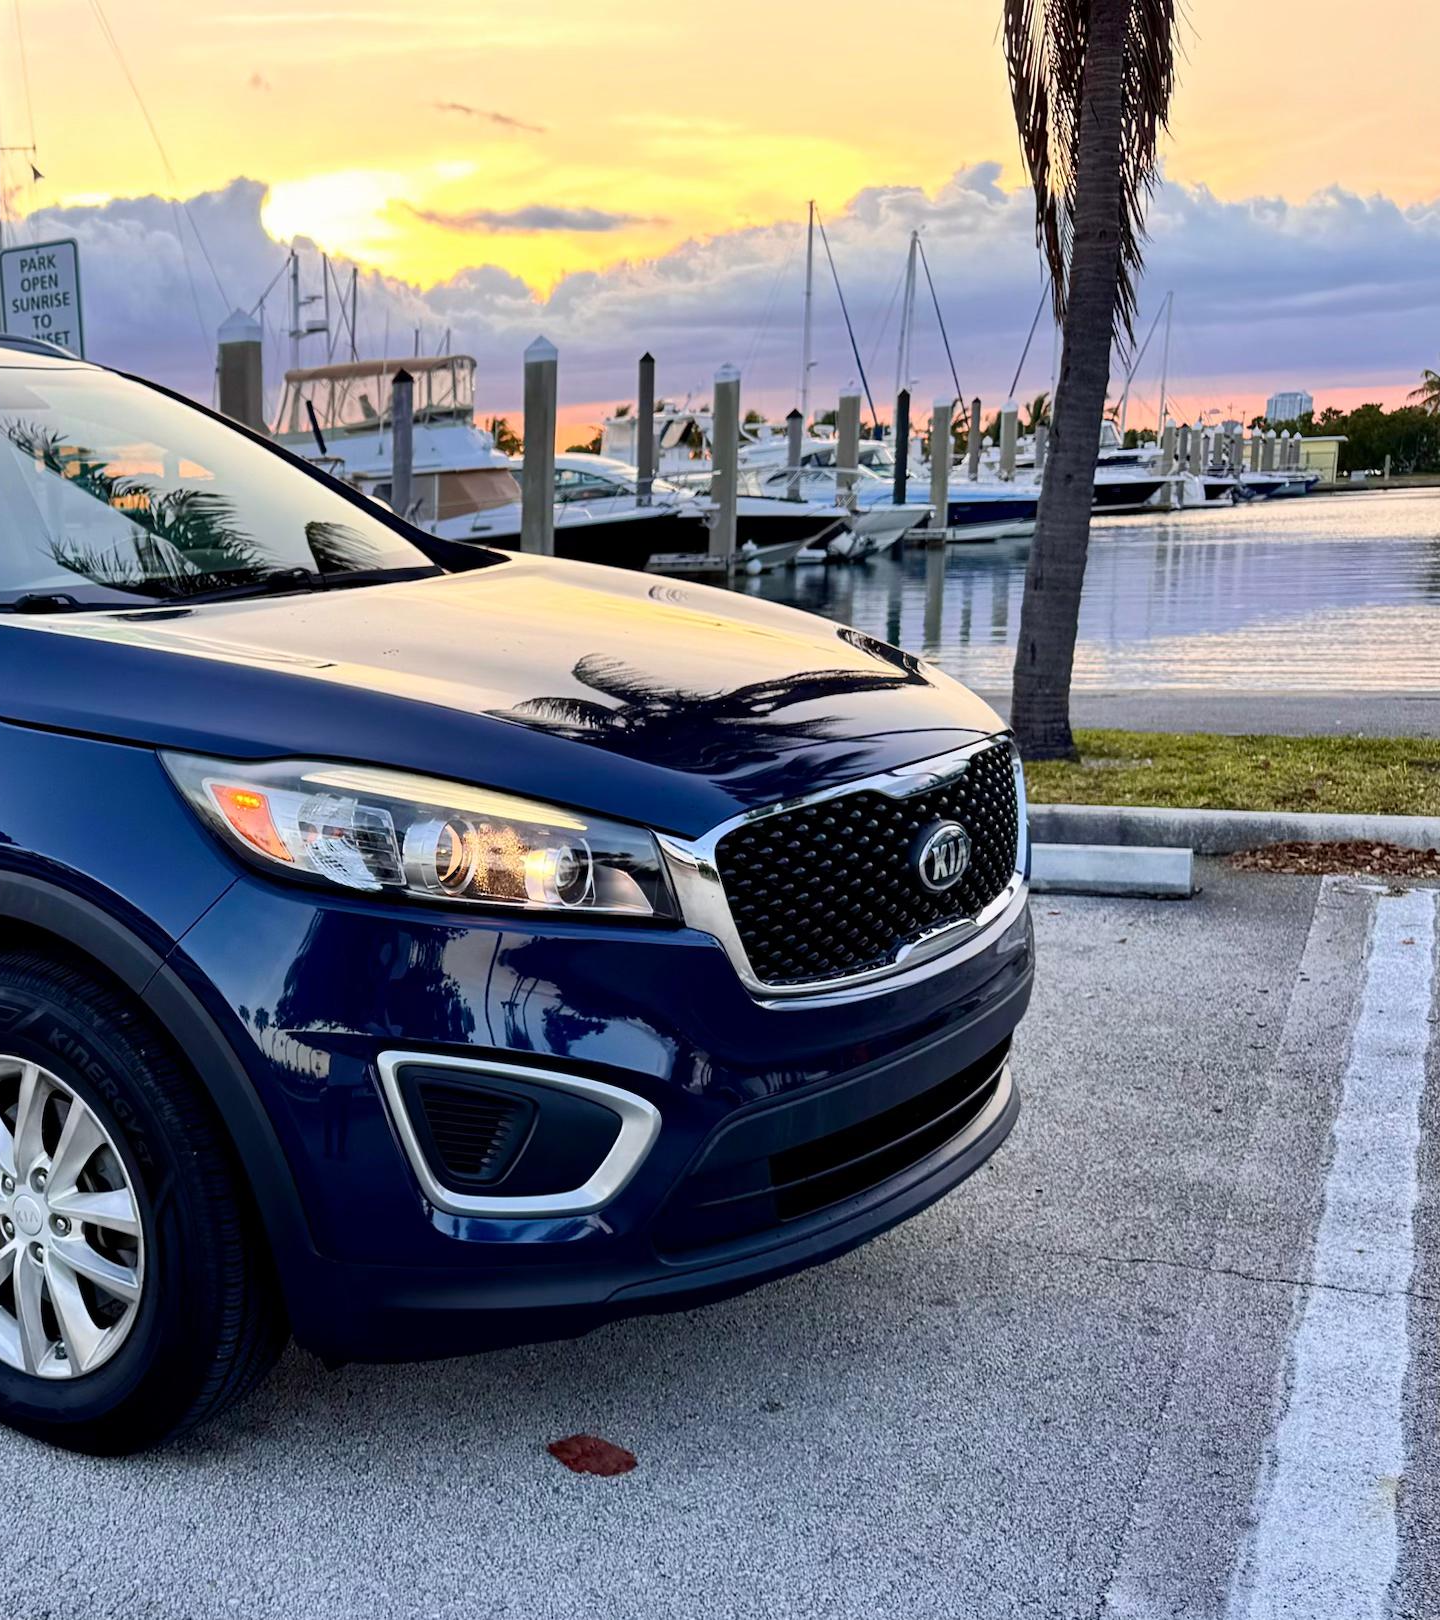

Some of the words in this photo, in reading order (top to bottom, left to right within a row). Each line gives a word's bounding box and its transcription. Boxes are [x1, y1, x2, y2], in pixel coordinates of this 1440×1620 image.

[20, 254, 56, 273] PARK
[21, 274, 58, 292] OPEN
[12, 292, 70, 314] SUNRISE
[33, 314, 52, 329] TO
[32, 331, 70, 346] SET
[931, 837, 967, 880] KIA
[16, 1210, 38, 1222] KIA
